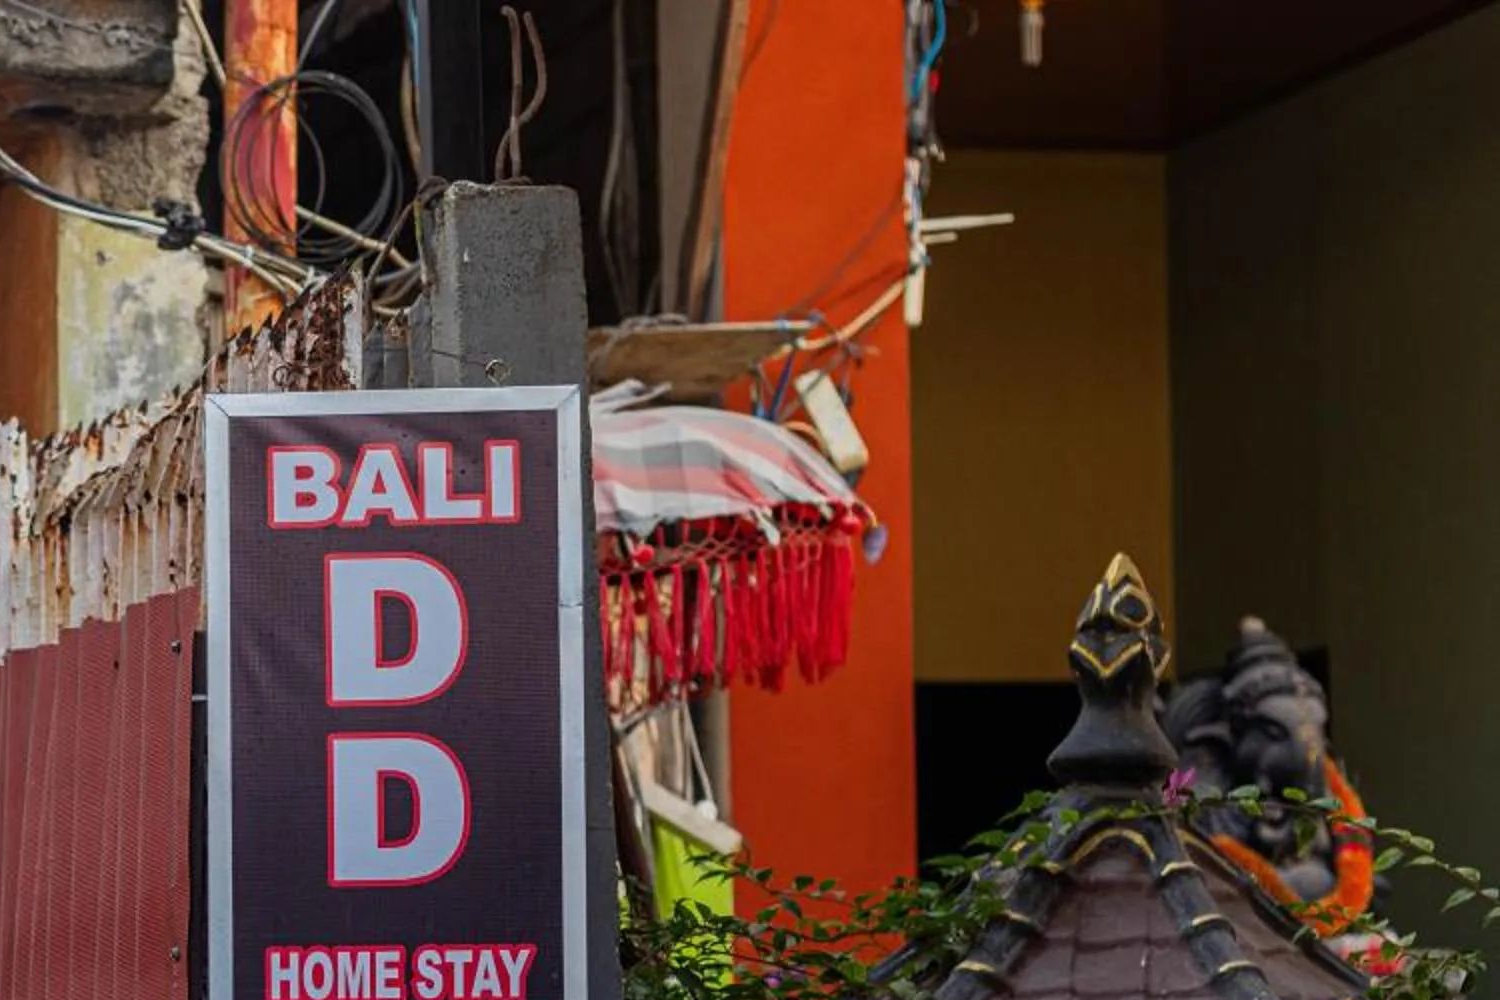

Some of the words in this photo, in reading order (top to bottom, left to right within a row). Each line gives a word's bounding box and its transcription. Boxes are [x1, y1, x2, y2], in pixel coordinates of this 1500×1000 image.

[268, 440, 520, 528] BALI
[324, 552, 469, 706] D
[327, 731, 472, 887] D
